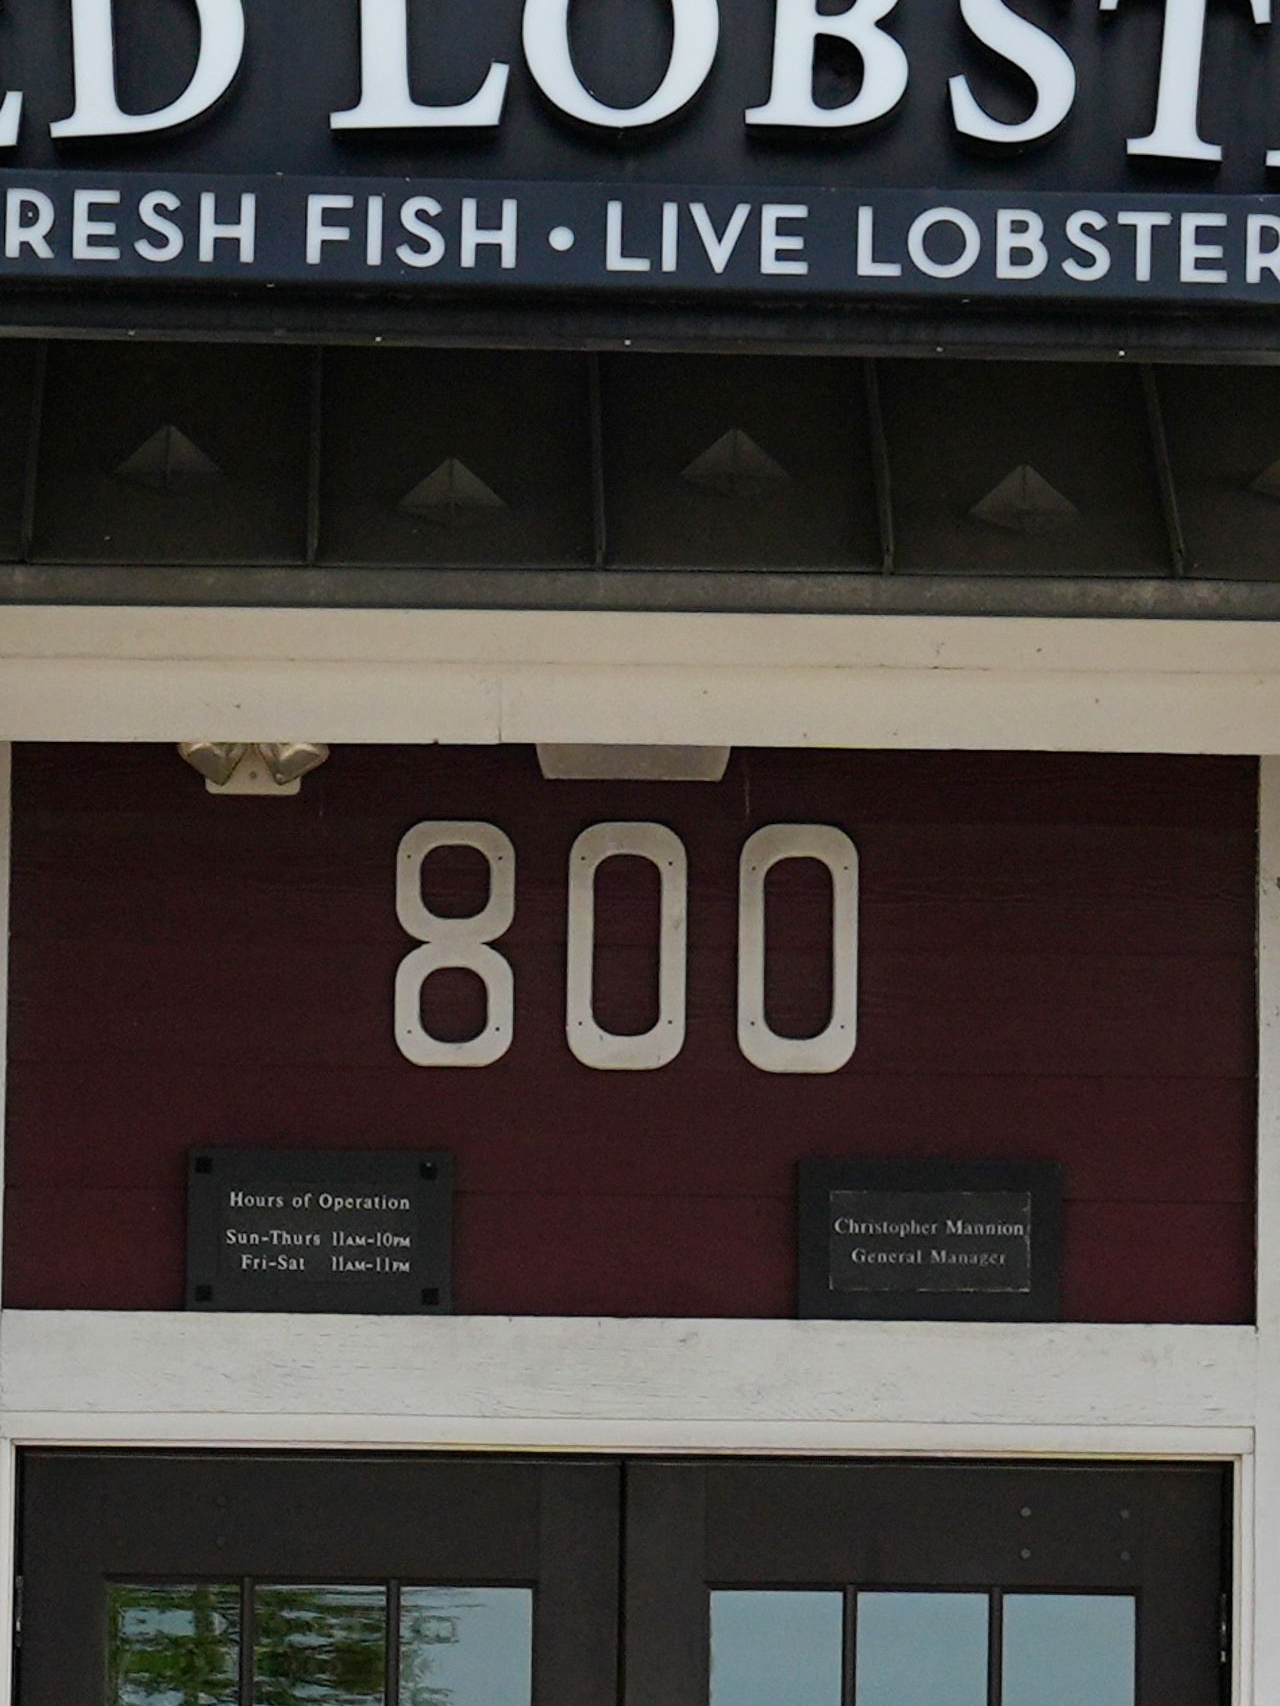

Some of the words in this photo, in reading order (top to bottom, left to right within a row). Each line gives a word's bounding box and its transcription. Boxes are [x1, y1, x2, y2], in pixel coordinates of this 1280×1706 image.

[305, 194, 518, 270] FISH
[605, 200, 809, 276] LIVE
[393, 820, 860, 1074] 800
[229, 1191, 284, 1209] Hours
[292, 1192, 313, 1210] of
[318, 1192, 410, 1212] Operation
[226, 1228, 321, 1247] Sun-Thurs
[834, 1217, 938, 1238] Christopher
[945, 1219, 1024, 1236] Mannion
[241, 1254, 306, 1272] Fri-Sat
[851, 1247, 922, 1264] General
[931, 1249, 1005, 1266] Manager
